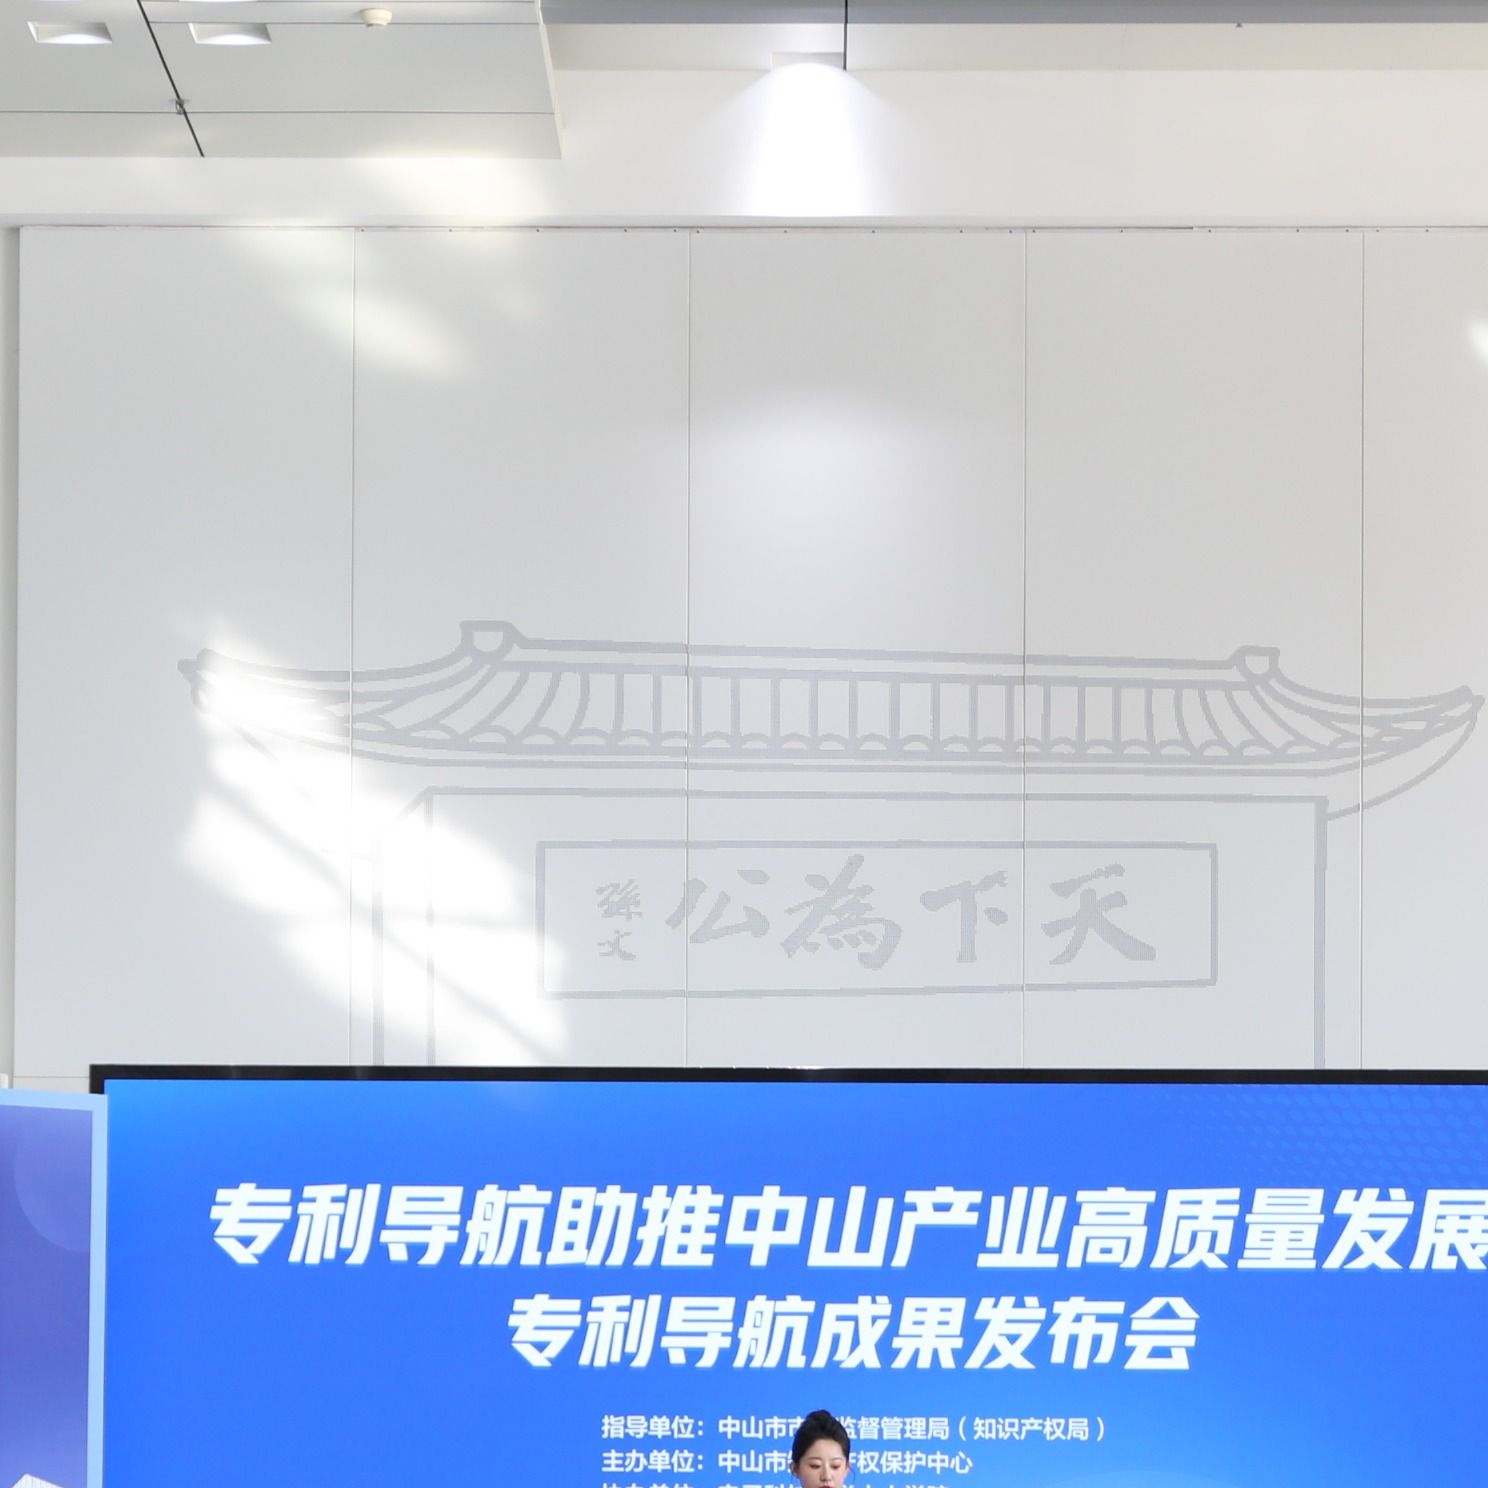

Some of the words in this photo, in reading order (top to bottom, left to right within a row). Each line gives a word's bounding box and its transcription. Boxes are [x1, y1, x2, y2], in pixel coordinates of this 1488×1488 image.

[507, 1294, 1200, 1370] 专利导航成果发布会
